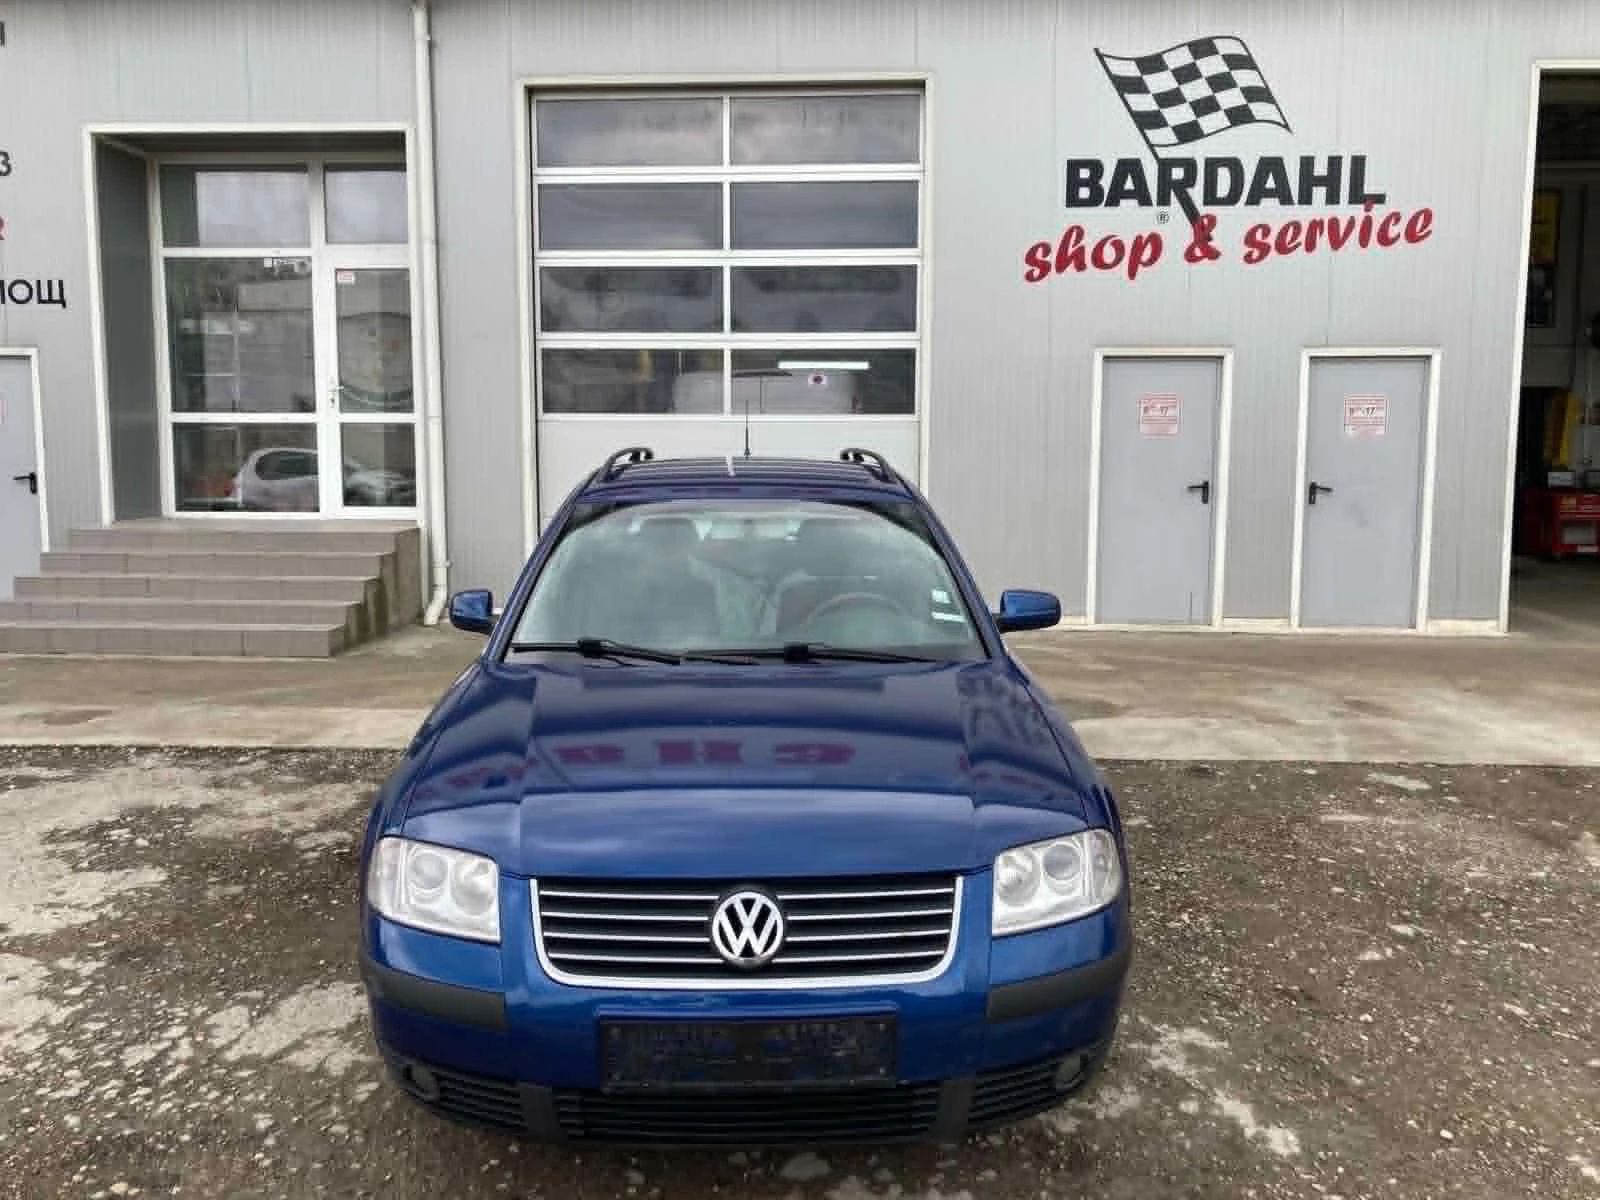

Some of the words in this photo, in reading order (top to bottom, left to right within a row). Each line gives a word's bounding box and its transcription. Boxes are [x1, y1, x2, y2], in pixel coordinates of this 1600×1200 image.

[1065, 155, 1387, 218] BARDAHL
[1023, 224, 1164, 283] shop
[1184, 213, 1221, 263] &
[1242, 201, 1434, 265] service
[0, 279, 66, 308] ОЩ
[712, 891, 784, 961] VW
